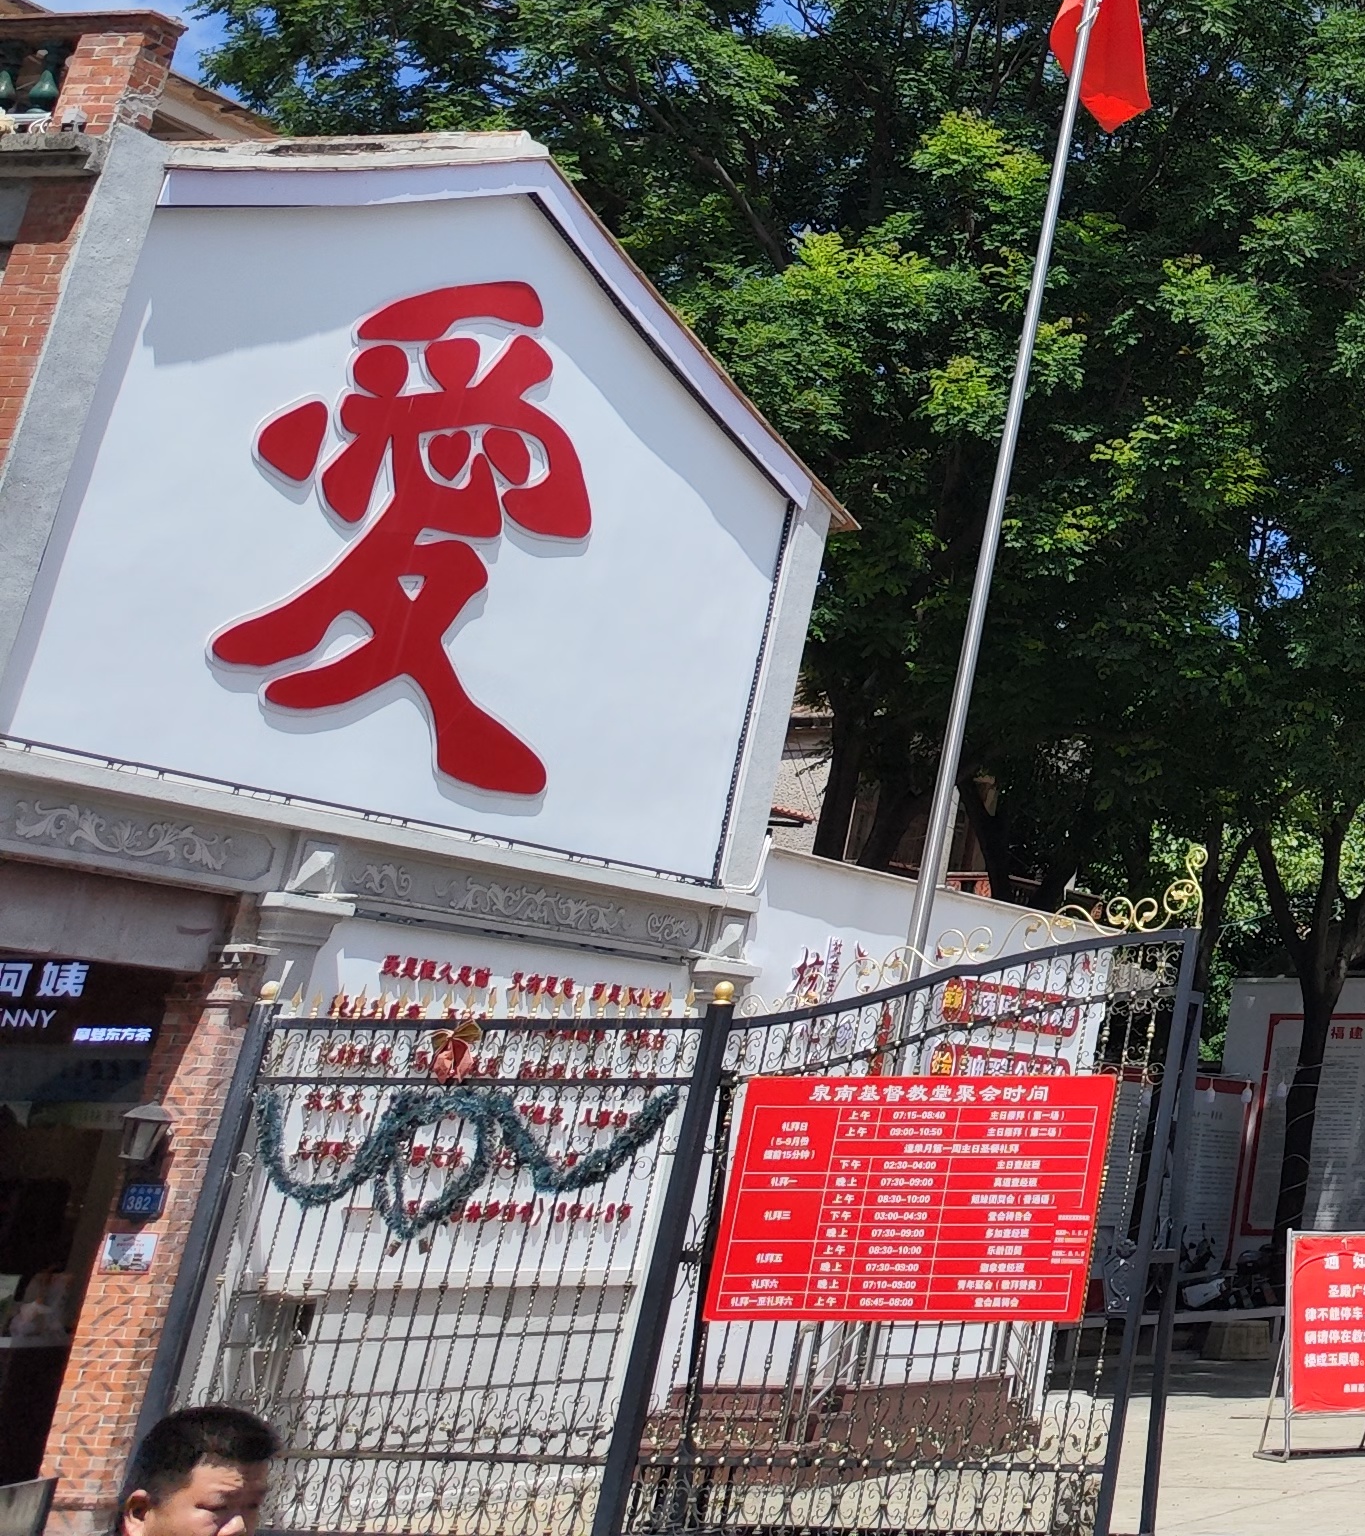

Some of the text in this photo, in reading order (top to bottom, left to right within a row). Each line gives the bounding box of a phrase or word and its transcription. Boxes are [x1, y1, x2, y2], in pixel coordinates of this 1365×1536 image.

[0, 1009, 57, 1029] NNY
[73, 1027, 153, 1042] 摩登东方茶
[808, 1084, 1050, 1103] 泉南基督教堂聚会时间
[848, 1110, 871, 1121] 上午
[781, 1122, 809, 1132] 礼拜日
[845, 1127, 868, 1137] 上午
[839, 1160, 861, 1170] 下午
[770, 1177, 798, 1187] 礼拜一
[835, 1177, 857, 1187] 晚上
[126, 1195, 151, 1210] 382
[832, 1194, 855, 1204] 上午
[764, 1211, 791, 1221] 礼拜三
[830, 1211, 852, 1221] 下午
[826, 1228, 848, 1238] 晚上
[823, 1245, 846, 1255] 上午
[756, 1253, 783, 1263] 礼拜五
[820, 1262, 842, 1272] 晚上
[751, 1279, 779, 1289] 礼拜六
[817, 1279, 839, 1289] 晚上
[814, 1297, 837, 1307] 上午
